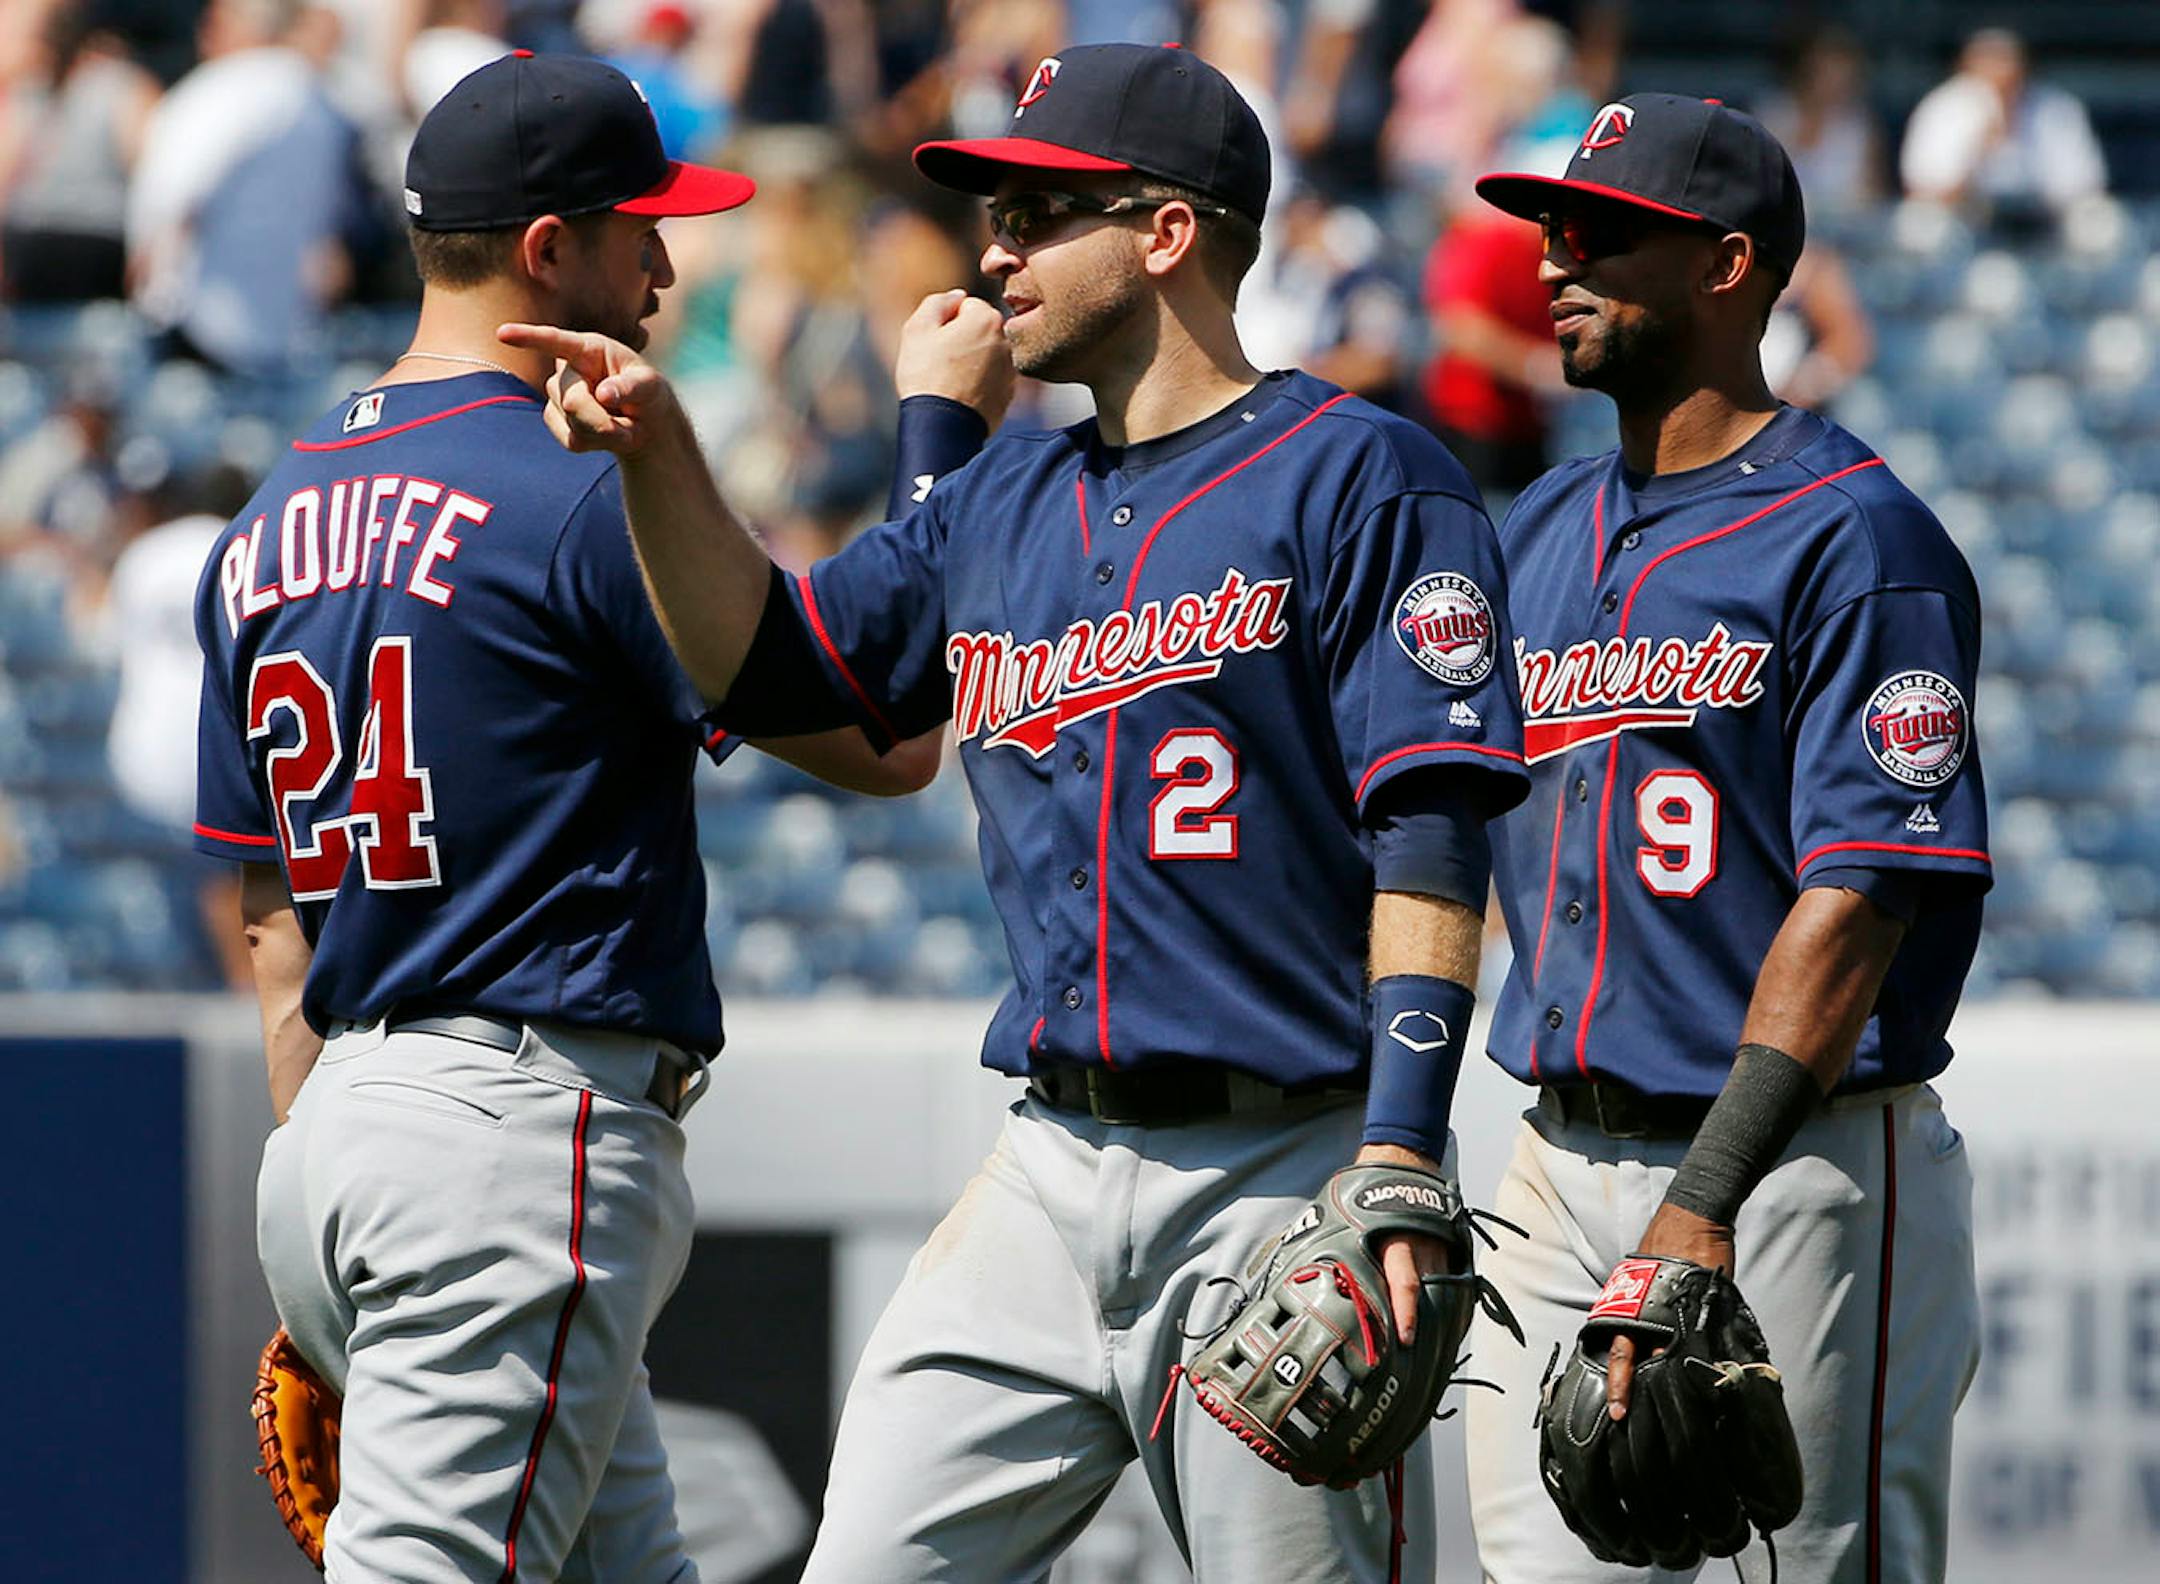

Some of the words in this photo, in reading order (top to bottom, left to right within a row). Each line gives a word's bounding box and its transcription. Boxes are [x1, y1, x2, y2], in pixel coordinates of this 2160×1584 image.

[220, 474, 493, 640] PLOUFFE
[1402, 577, 1486, 613] MINNESOTA
[947, 567, 1293, 748] Minnesota
[1401, 604, 1490, 648] Twins
[1514, 622, 1774, 717] nnesota
[1869, 704, 1963, 750] Twins
[1873, 675, 1960, 711] MINNESOTA
[247, 635, 441, 902] 24
[1149, 727, 1240, 860] 2
[1634, 768, 1720, 899] 9
[1362, 1184, 1445, 1213] Wilson
[1348, 1375, 1400, 1456] A2000
